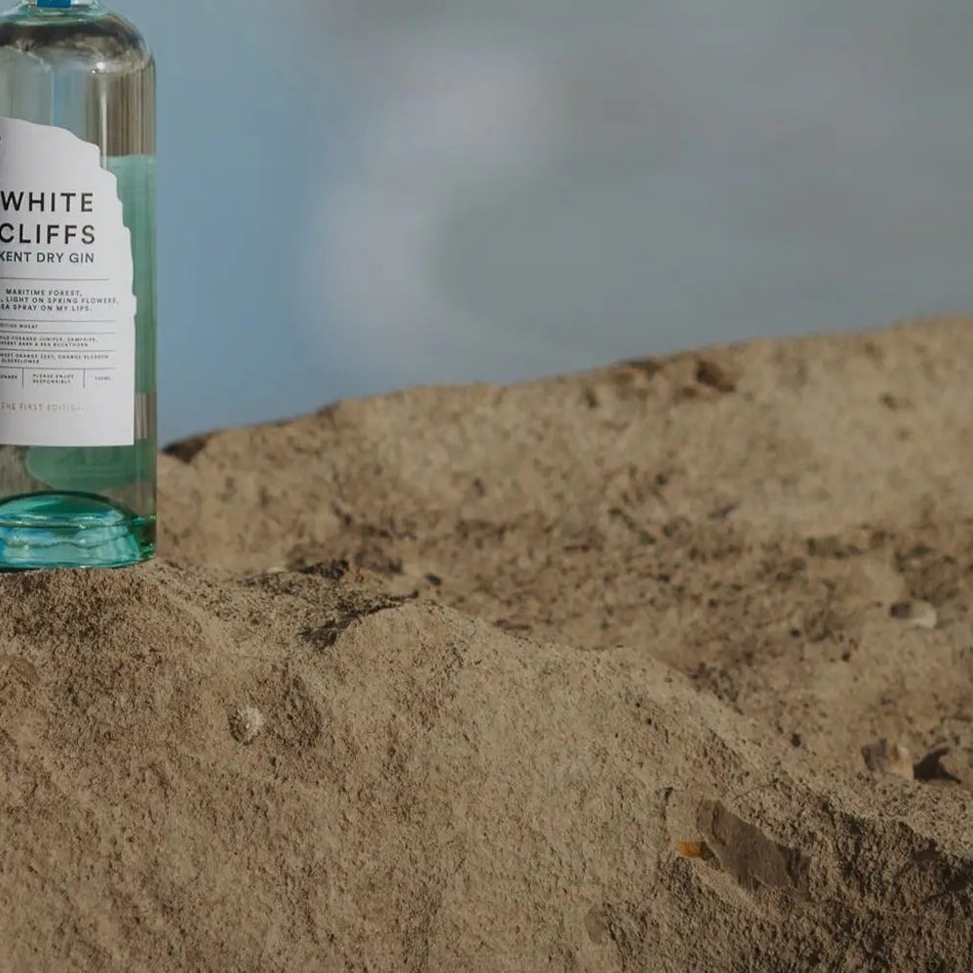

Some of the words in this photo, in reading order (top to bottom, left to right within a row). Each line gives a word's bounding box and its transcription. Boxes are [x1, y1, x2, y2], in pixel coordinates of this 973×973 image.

[0, 190, 93, 213] WHITE
[36, 251, 64, 263] DRY
[69, 252, 94, 264] GIN
[5, 288, 45, 296] MARITIME
[48, 289, 83, 297] FOREST,
[13, 303, 37, 311] SPRAY
[19, 402, 43, 411] FIRST
